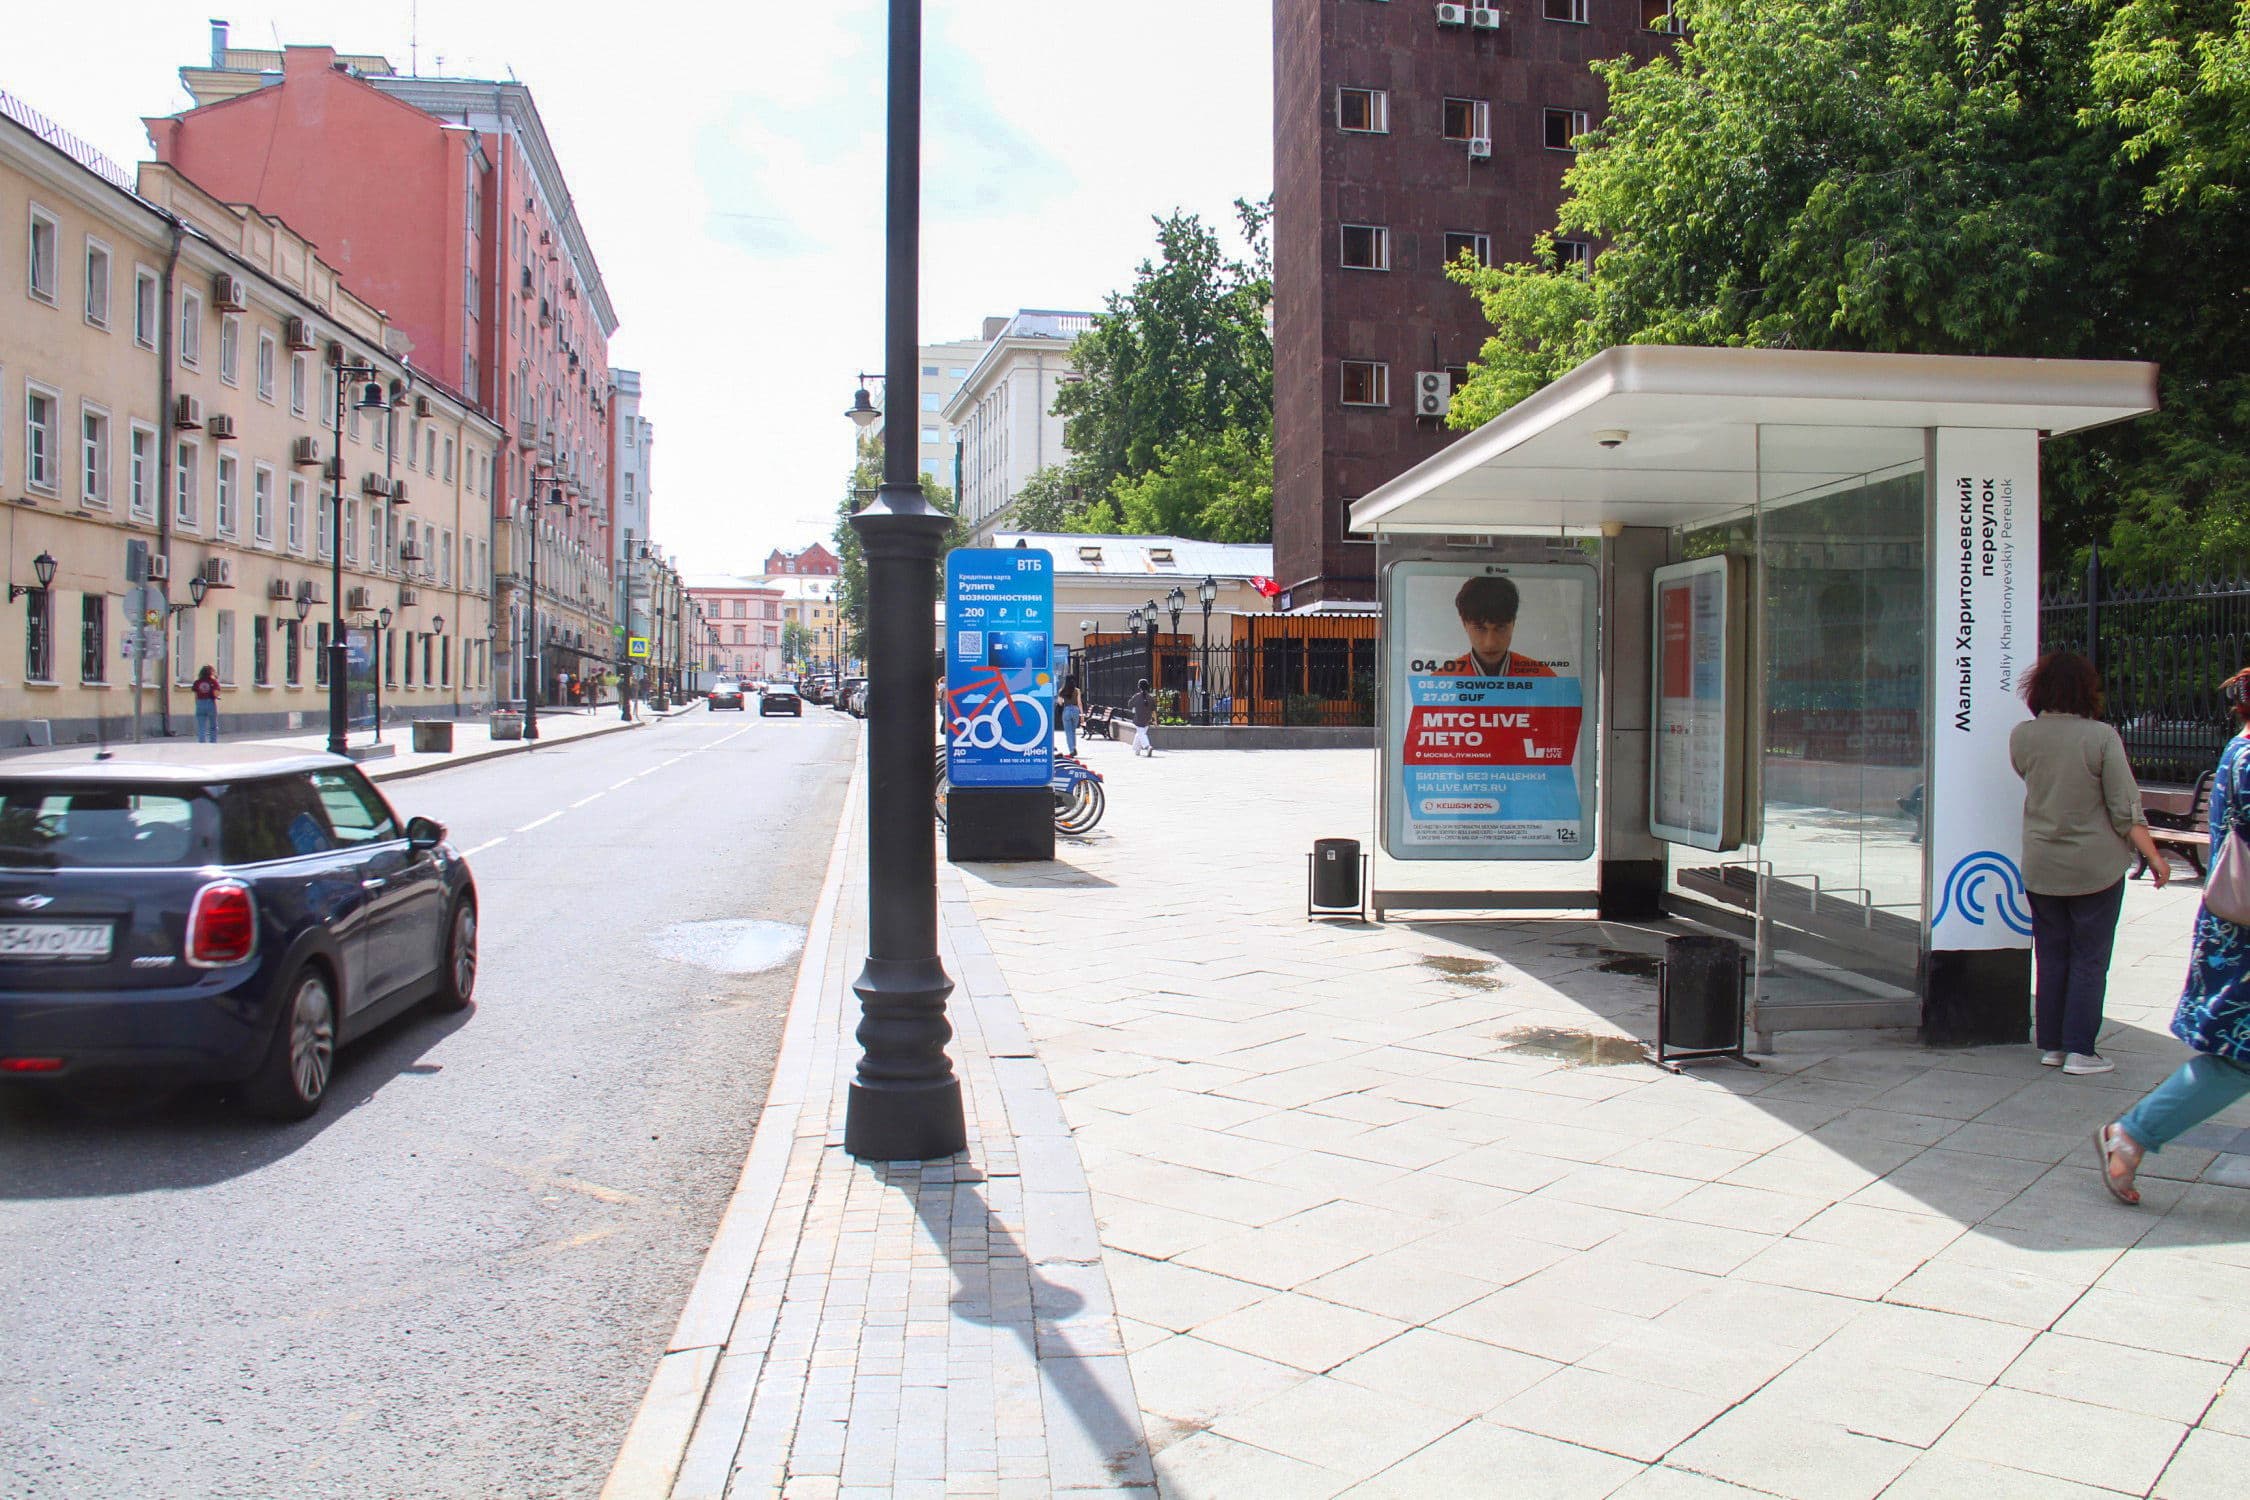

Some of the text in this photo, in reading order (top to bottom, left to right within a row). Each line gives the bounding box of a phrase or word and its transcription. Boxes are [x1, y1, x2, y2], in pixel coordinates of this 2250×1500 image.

[1982, 478, 1997, 576] переулок
[1017, 559, 1042, 571] ВТБ
[959, 582, 995, 592] Рулите
[2000, 478, 2015, 693] Maliy Kharitonyevskiy Pereulok
[959, 594, 1043, 602] возможностями
[1955, 477, 1976, 732] Малый Харитоньевский
[1411, 659, 1467, 672] 04.07
[1456, 681, 1504, 690] SQWOZ
[1507, 681, 1533, 690] BAB
[1422, 693, 1485, 702] 27.07 GUF
[1422, 713, 1530, 728] МТС LIVE
[1418, 731, 1483, 747] ЛЕТО
[953, 747, 1048, 757] до дней
[1415, 772, 1547, 782] БИЛЕТЫ БЕЗ НАЦЕНКИ
[1417, 784, 1507, 792] НА LIVE.MTS.RU
[1556, 828, 1576, 840] 12+
